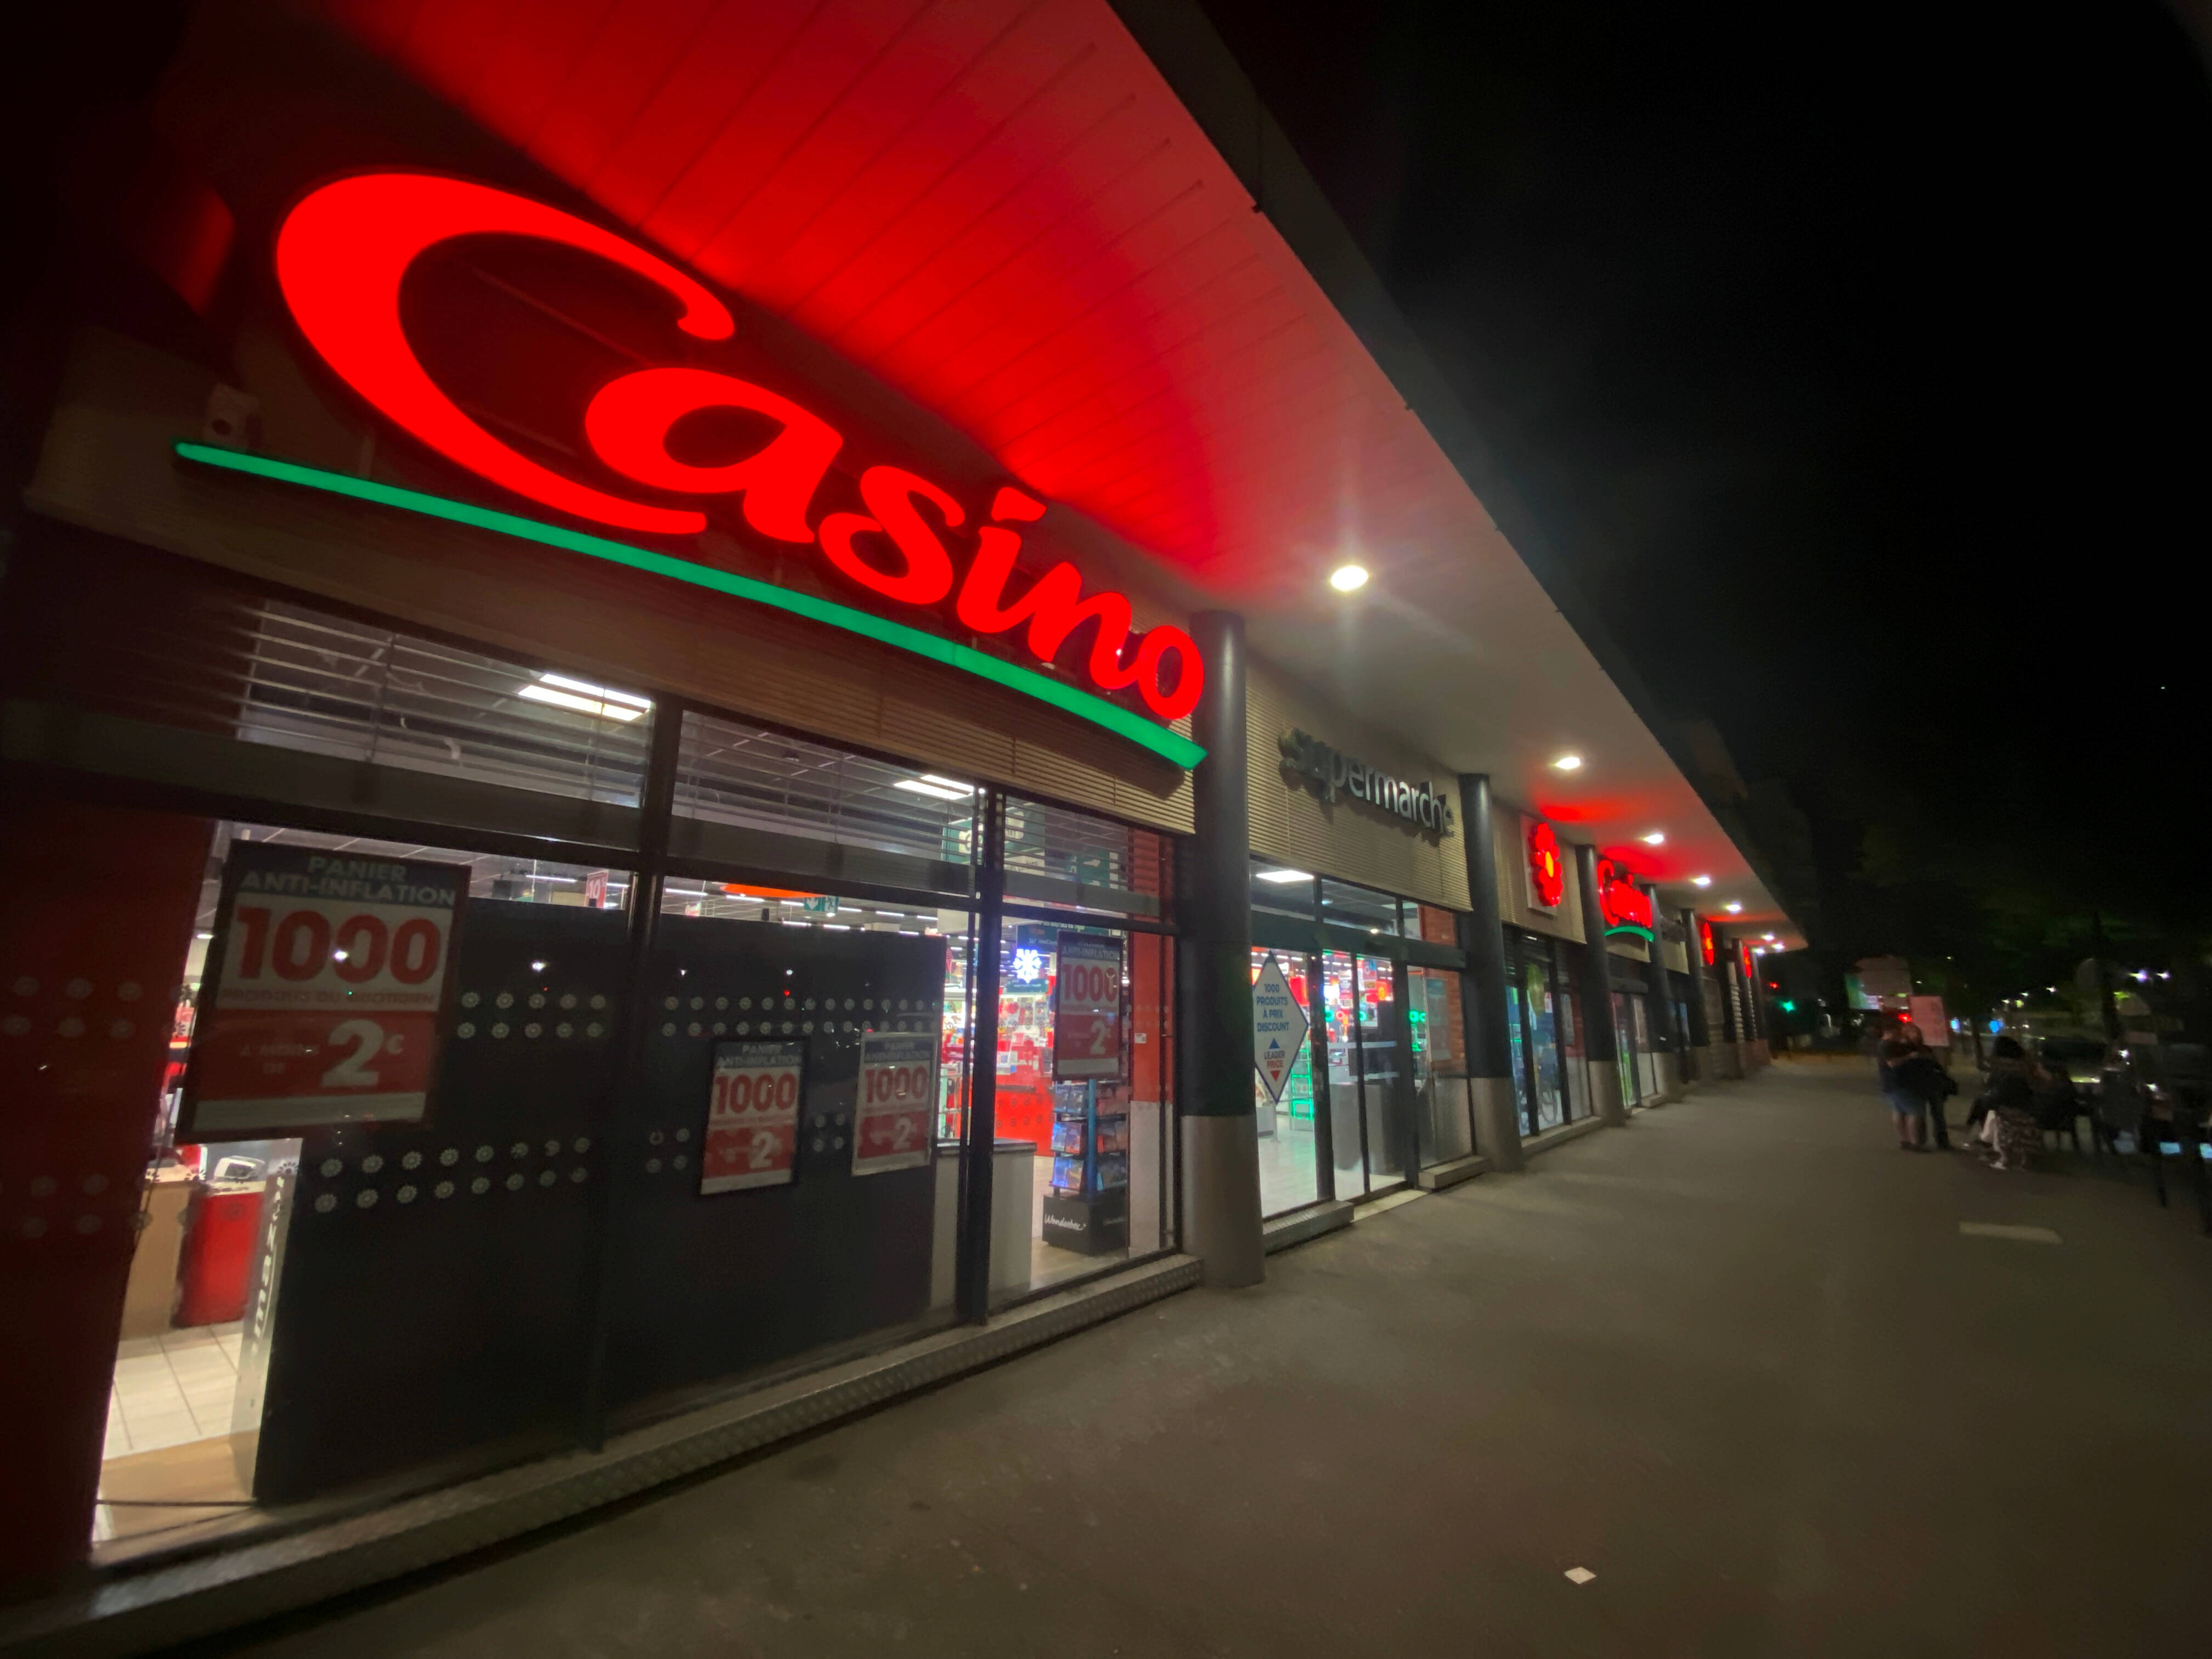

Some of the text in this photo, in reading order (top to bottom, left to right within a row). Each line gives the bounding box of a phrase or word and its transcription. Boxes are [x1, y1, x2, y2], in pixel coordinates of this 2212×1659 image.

[275, 172, 1204, 721] Casino
[308, 856, 407, 881] PANIER
[240, 870, 456, 906] ANTI-INFLATION
[236, 907, 439, 985] 1000
[1062, 964, 1118, 1002] 1000
[1264, 984, 1280, 993] 1000
[1256, 996, 1288, 1006] PRODUITS
[1269, 1009, 1283, 1019] PRIX
[1257, 1022, 1289, 1032] DISCOUNT
[1264, 1051, 1285, 1060] LEADER
[716, 1073, 796, 1115] 1000
[865, 1066, 928, 1103] 1000
